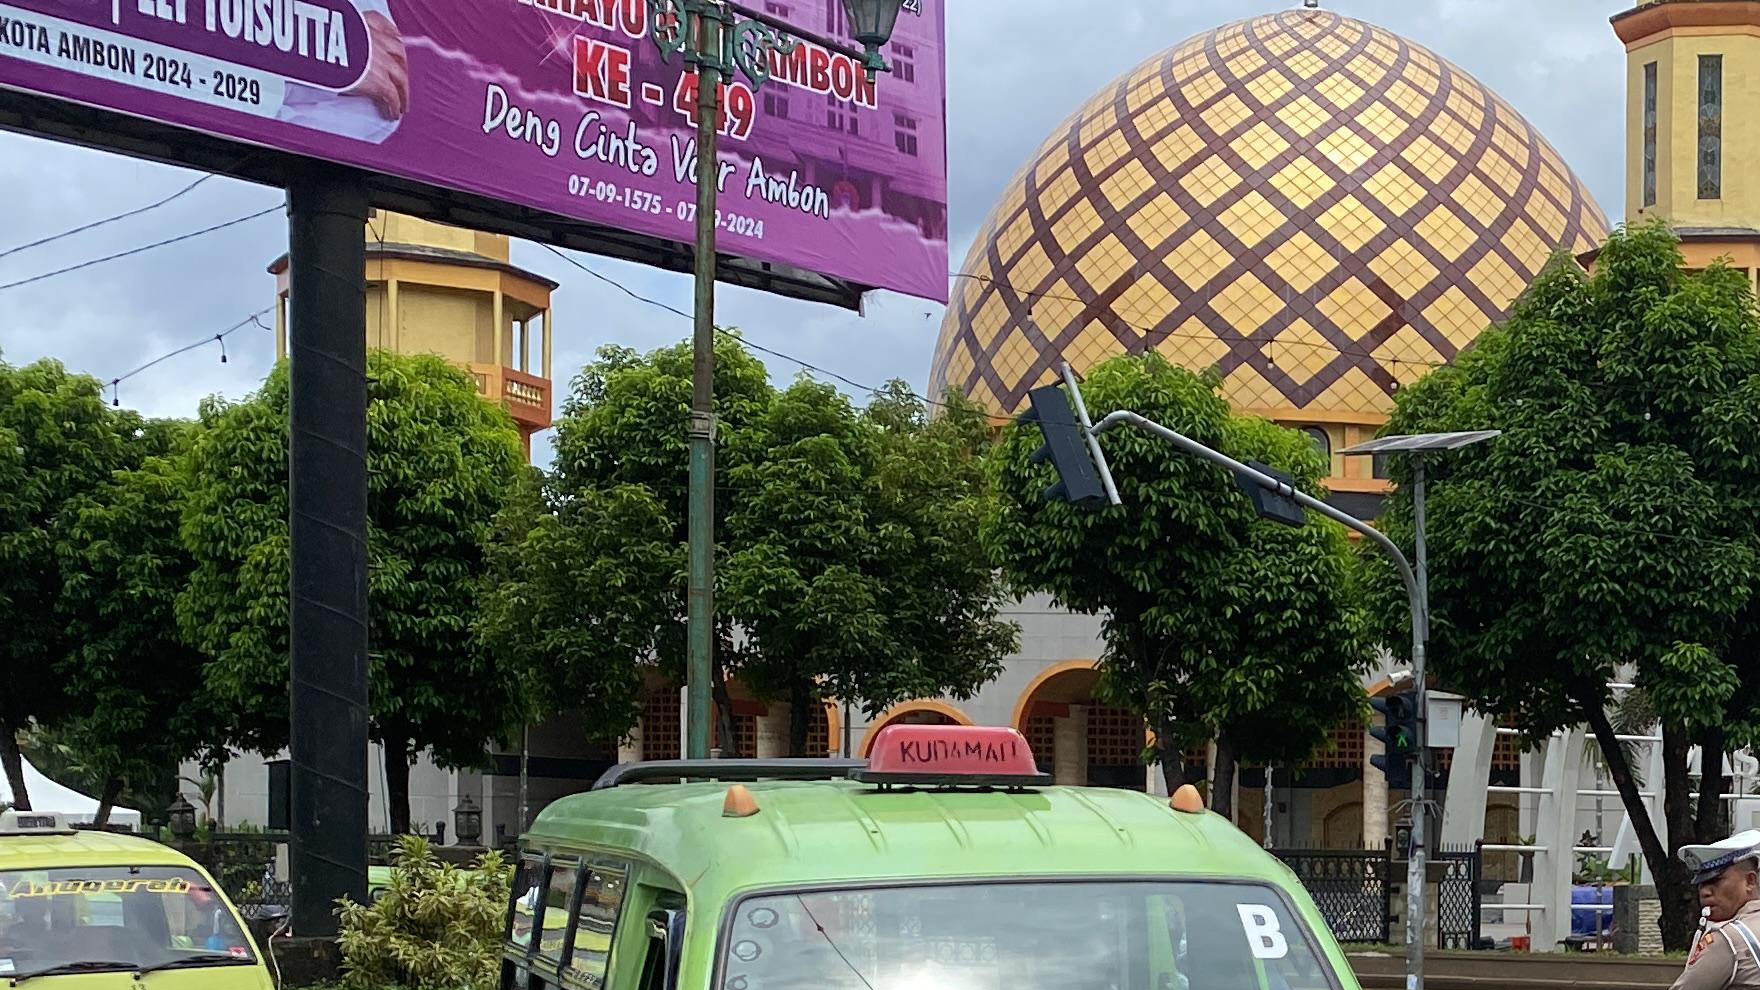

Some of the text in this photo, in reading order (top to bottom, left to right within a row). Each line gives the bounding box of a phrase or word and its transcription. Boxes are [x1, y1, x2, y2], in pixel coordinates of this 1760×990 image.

[57, 31, 136, 75] AMBON
[143, 52, 192, 89] 2024
[213, 70, 260, 105] 2029
[573, 35, 632, 108] KE
[482, 83, 830, 219] Deng Cinta Vor Ambon
[568, 174, 662, 215] 07-09-1575
[676, 200, 764, 239] 079-2024
[1236, 903, 1289, 959] B
